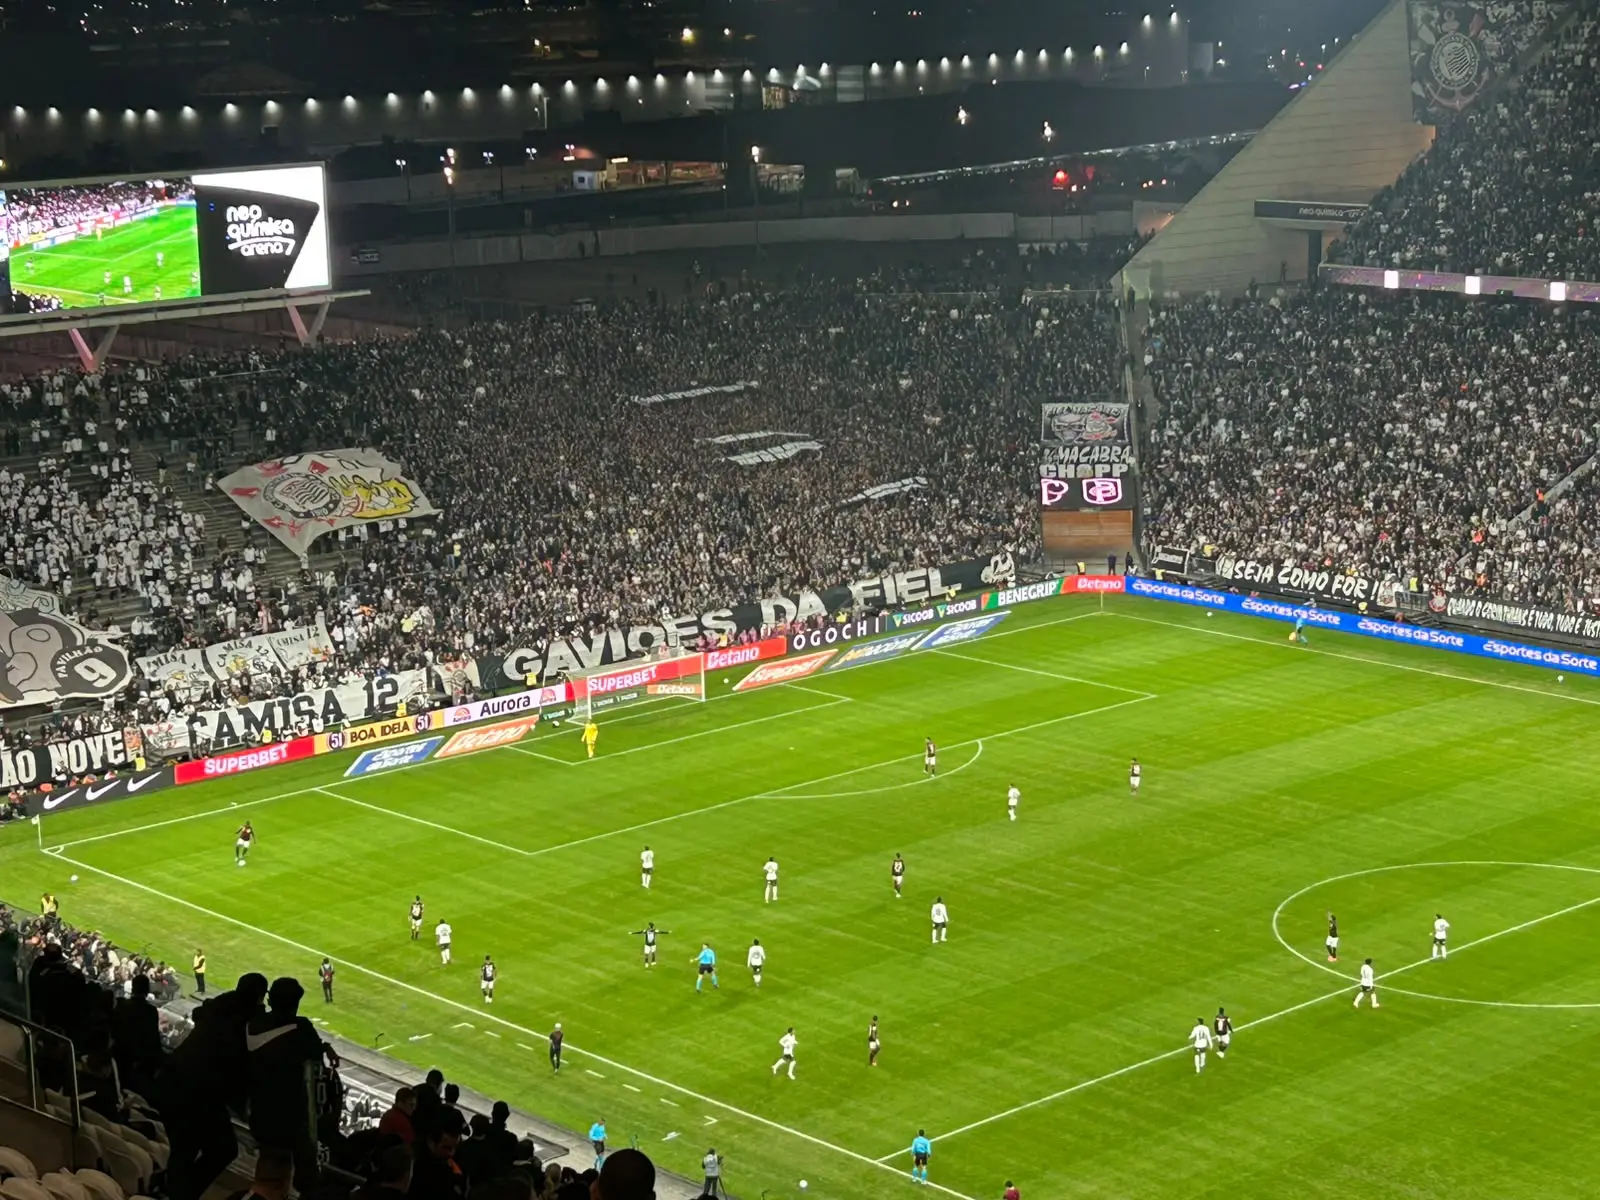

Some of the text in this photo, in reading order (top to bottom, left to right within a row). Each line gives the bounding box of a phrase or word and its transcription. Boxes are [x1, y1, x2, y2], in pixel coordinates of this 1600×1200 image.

[226, 204, 262, 223] neo
[240, 241, 284, 256] arena
[1077, 578, 1122, 590] Betano
[1234, 559, 1274, 583] SEJA
[1278, 567, 1329, 591] COMO
[761, 591, 827, 628] DA
[849, 568, 961, 606] FIEL
[998, 581, 1057, 605] BENEGRIP
[1132, 580, 1225, 604] Esportes da Sorte
[902, 608, 934, 624] SICOOB
[946, 600, 977, 615] SICOOB
[1242, 599, 1292, 617] Esportes
[1309, 608, 1341, 625] Sorte
[1358, 619, 1464, 647] Esportes da Sorte
[707, 646, 760, 668] Betano
[1483, 641, 1598, 670] Esportes da Sorte
[74, 658, 117, 688] 9
[588, 667, 657, 691] SUPERBET
[363, 677, 399, 717] 12
[480, 696, 531, 717] Aurora
[416, 715, 430, 731] 51
[330, 723, 410, 749] 51 BOA IDEIA
[48, 731, 125, 778] NOVE
[204, 744, 288, 774] SUPERBET
